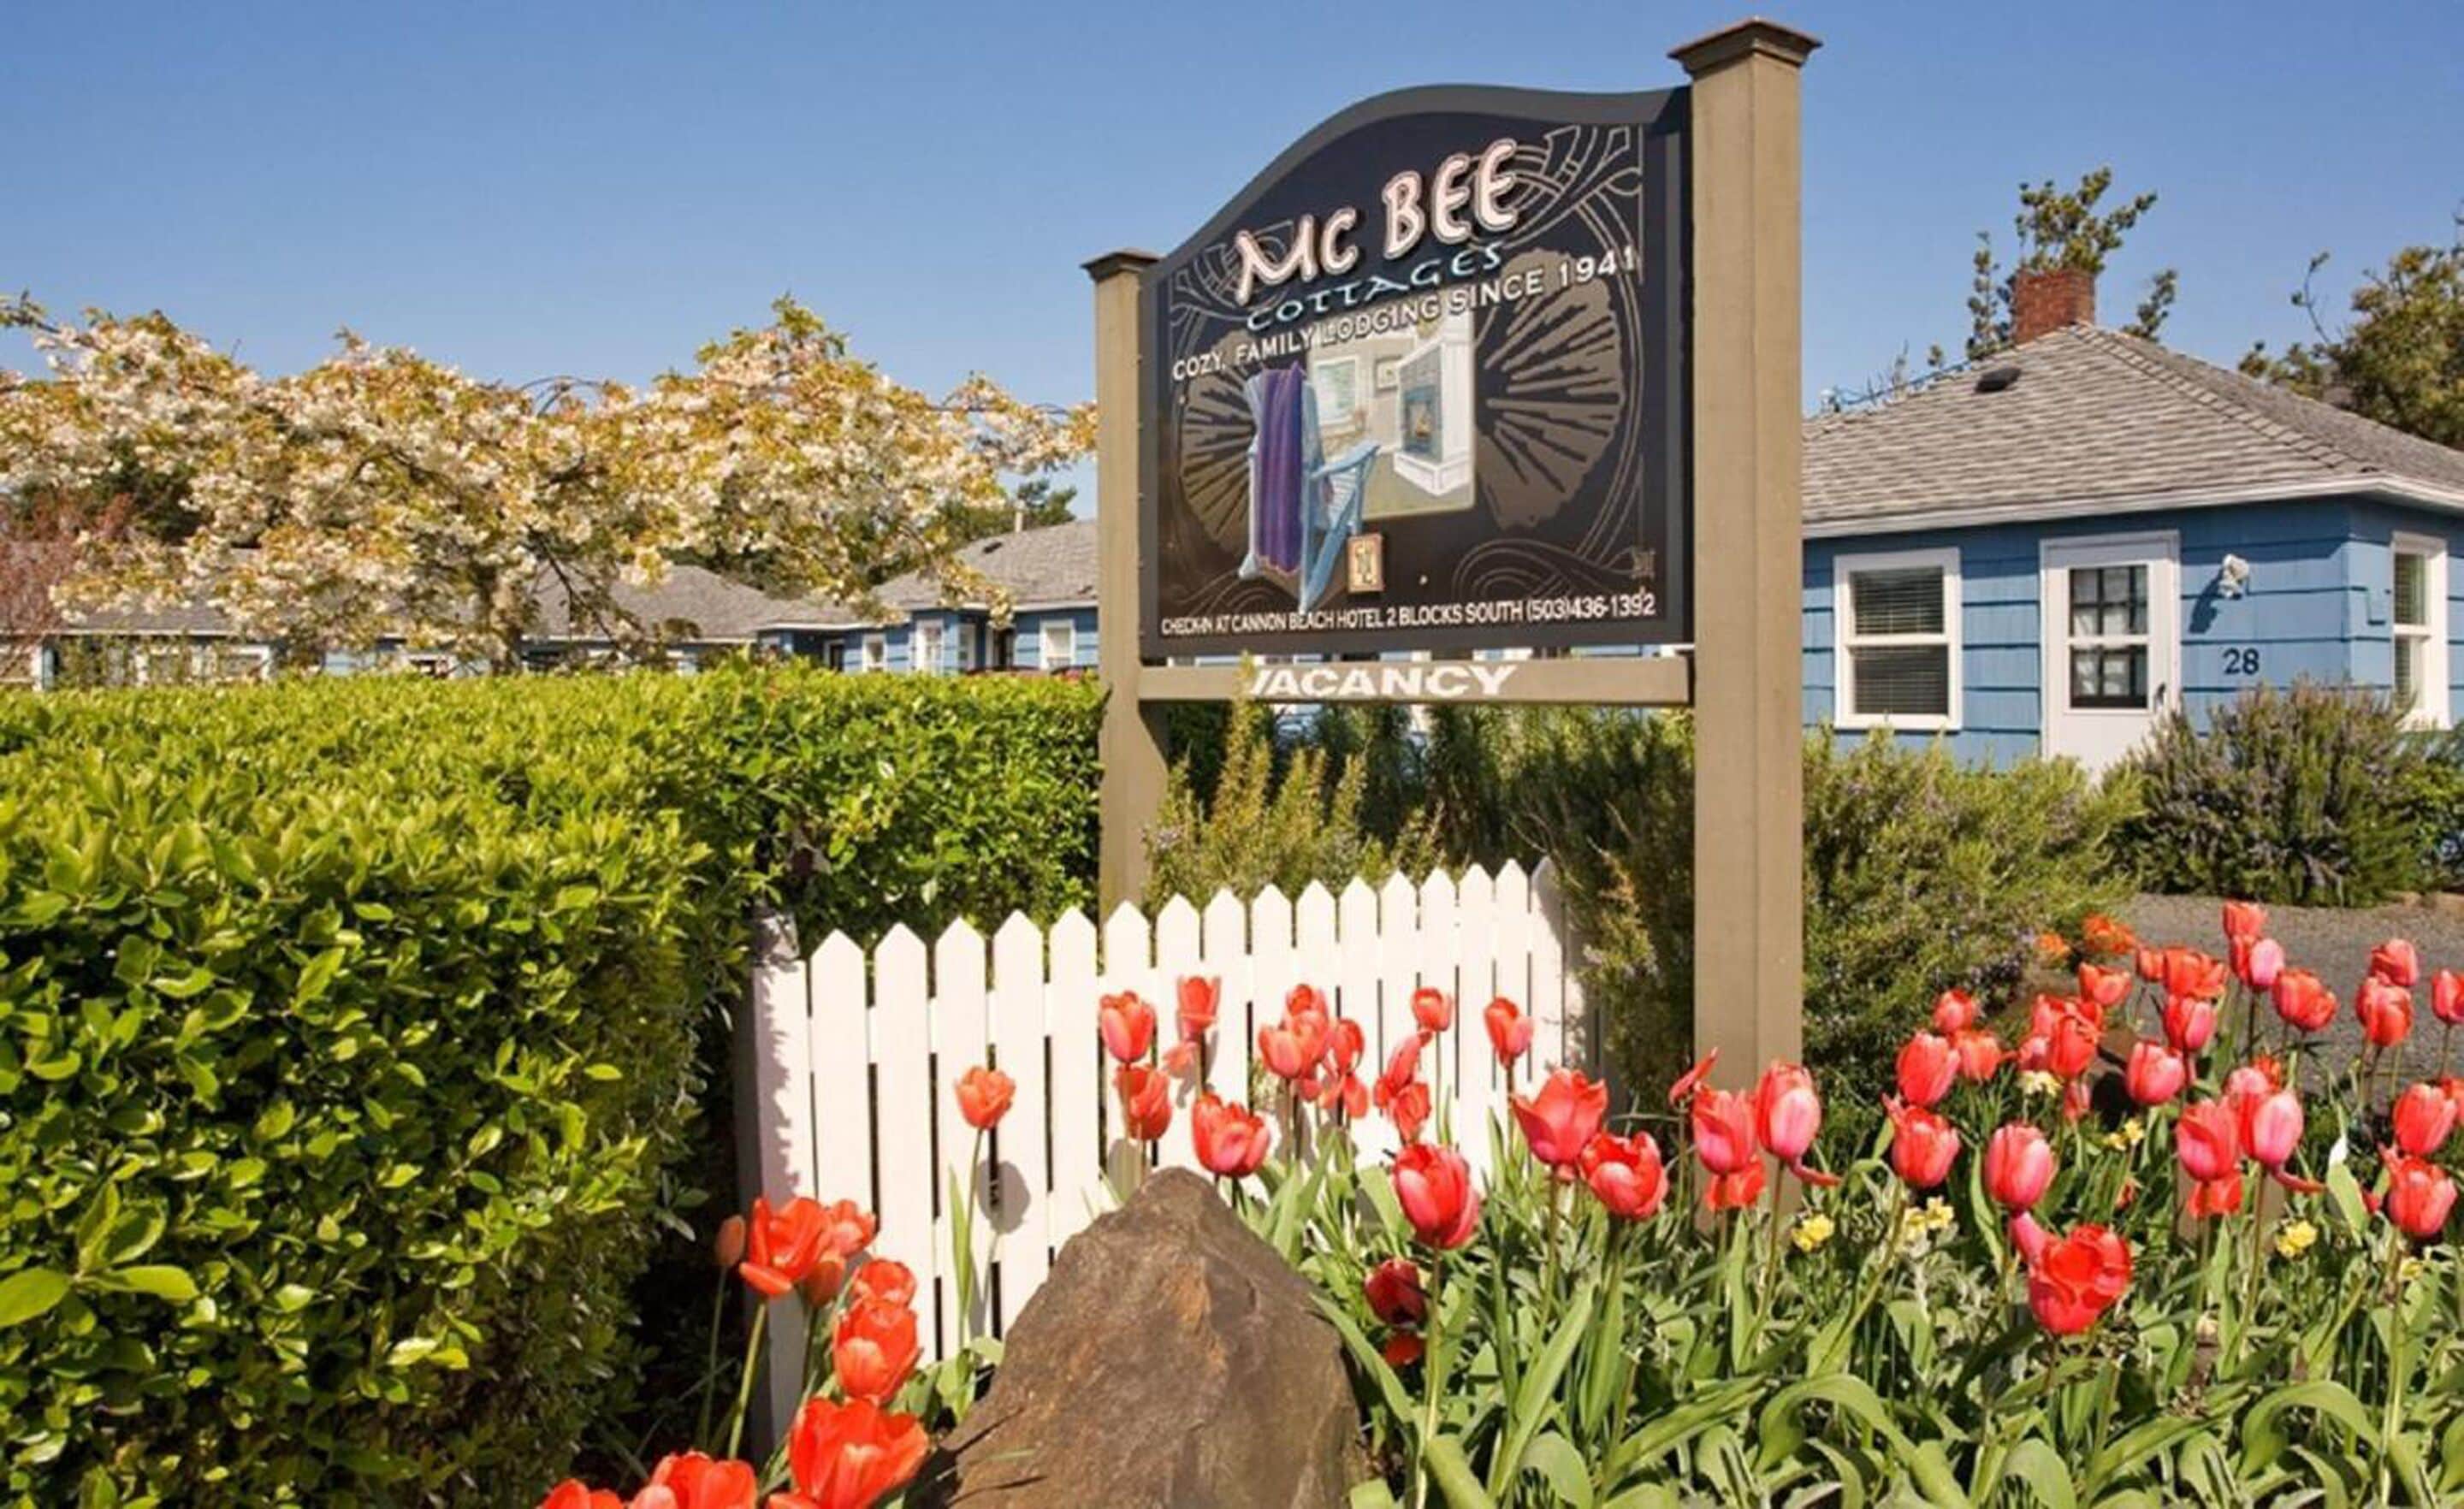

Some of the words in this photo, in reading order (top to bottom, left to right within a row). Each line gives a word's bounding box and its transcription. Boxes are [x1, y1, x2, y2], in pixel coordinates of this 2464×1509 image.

[1382, 138, 1519, 258] BEE
[1236, 328, 1315, 363] FAMILY
[1318, 296, 1441, 346] LODGING
[1448, 268, 1543, 310] SINCE
[1561, 245, 1635, 287] 1941
[1247, 243, 1502, 330] COTTAGES
[1216, 614, 1231, 634] AT
[1232, 611, 1286, 633] CANNON
[1288, 607, 1336, 630] BEACH
[1337, 607, 1383, 630] HOTEL
[1386, 607, 1395, 627] 2
[1399, 604, 1462, 627] BLOCKS
[1465, 601, 1524, 624] SOUTH
[2223, 648, 2260, 676] 28
